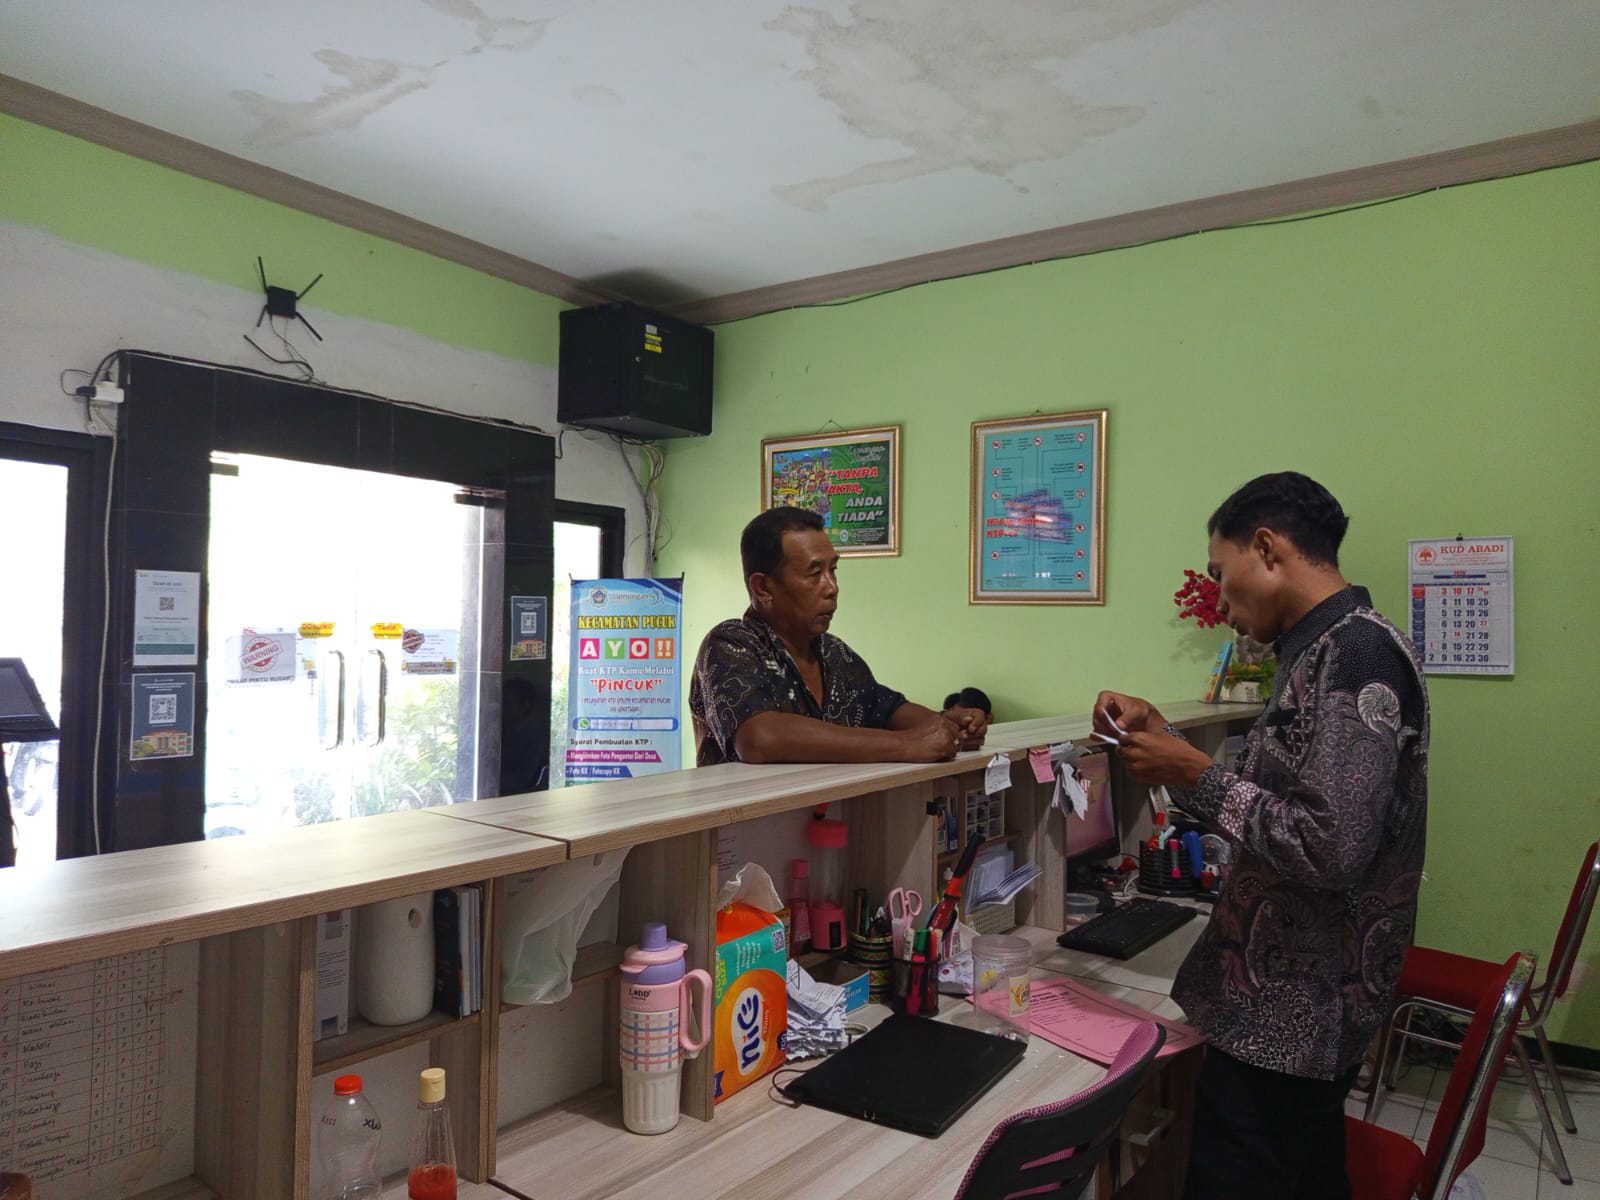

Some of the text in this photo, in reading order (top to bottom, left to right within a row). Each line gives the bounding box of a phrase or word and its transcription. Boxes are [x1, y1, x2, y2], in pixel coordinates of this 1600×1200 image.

[846, 496, 882, 507] ANDA
[1440, 544, 1505, 554] KUD ABADI
[1441, 587, 1447, 595] 3
[1453, 587, 1462, 595] 10
[1466, 587, 1475, 595] 17
[1441, 598, 1447, 606] 4
[1453, 598, 1462, 606] 11
[1478, 598, 1489, 606] 25
[1453, 609, 1462, 617] 12
[1466, 609, 1475, 617] 19
[1478, 609, 1489, 617] 26
[578, 615, 676, 629] KECAMATAN PUCUK
[1453, 620, 1462, 628] 13
[1465, 620, 1475, 628] 20
[1441, 632, 1447, 640] 7
[1466, 632, 1475, 640] 21
[1478, 632, 1489, 640] 28
[1441, 643, 1447, 651] 8
[1453, 643, 1462, 651] 15
[1465, 643, 1475, 651] 22
[1478, 643, 1489, 651] 29
[243, 643, 281, 665] WARNING
[1441, 654, 1447, 662] 9
[1453, 654, 1462, 662] 16
[1465, 654, 1475, 662] 23
[1478, 654, 1489, 662] 30
[600, 666, 617, 675] KTP
[570, 738, 593, 747] Syarat
